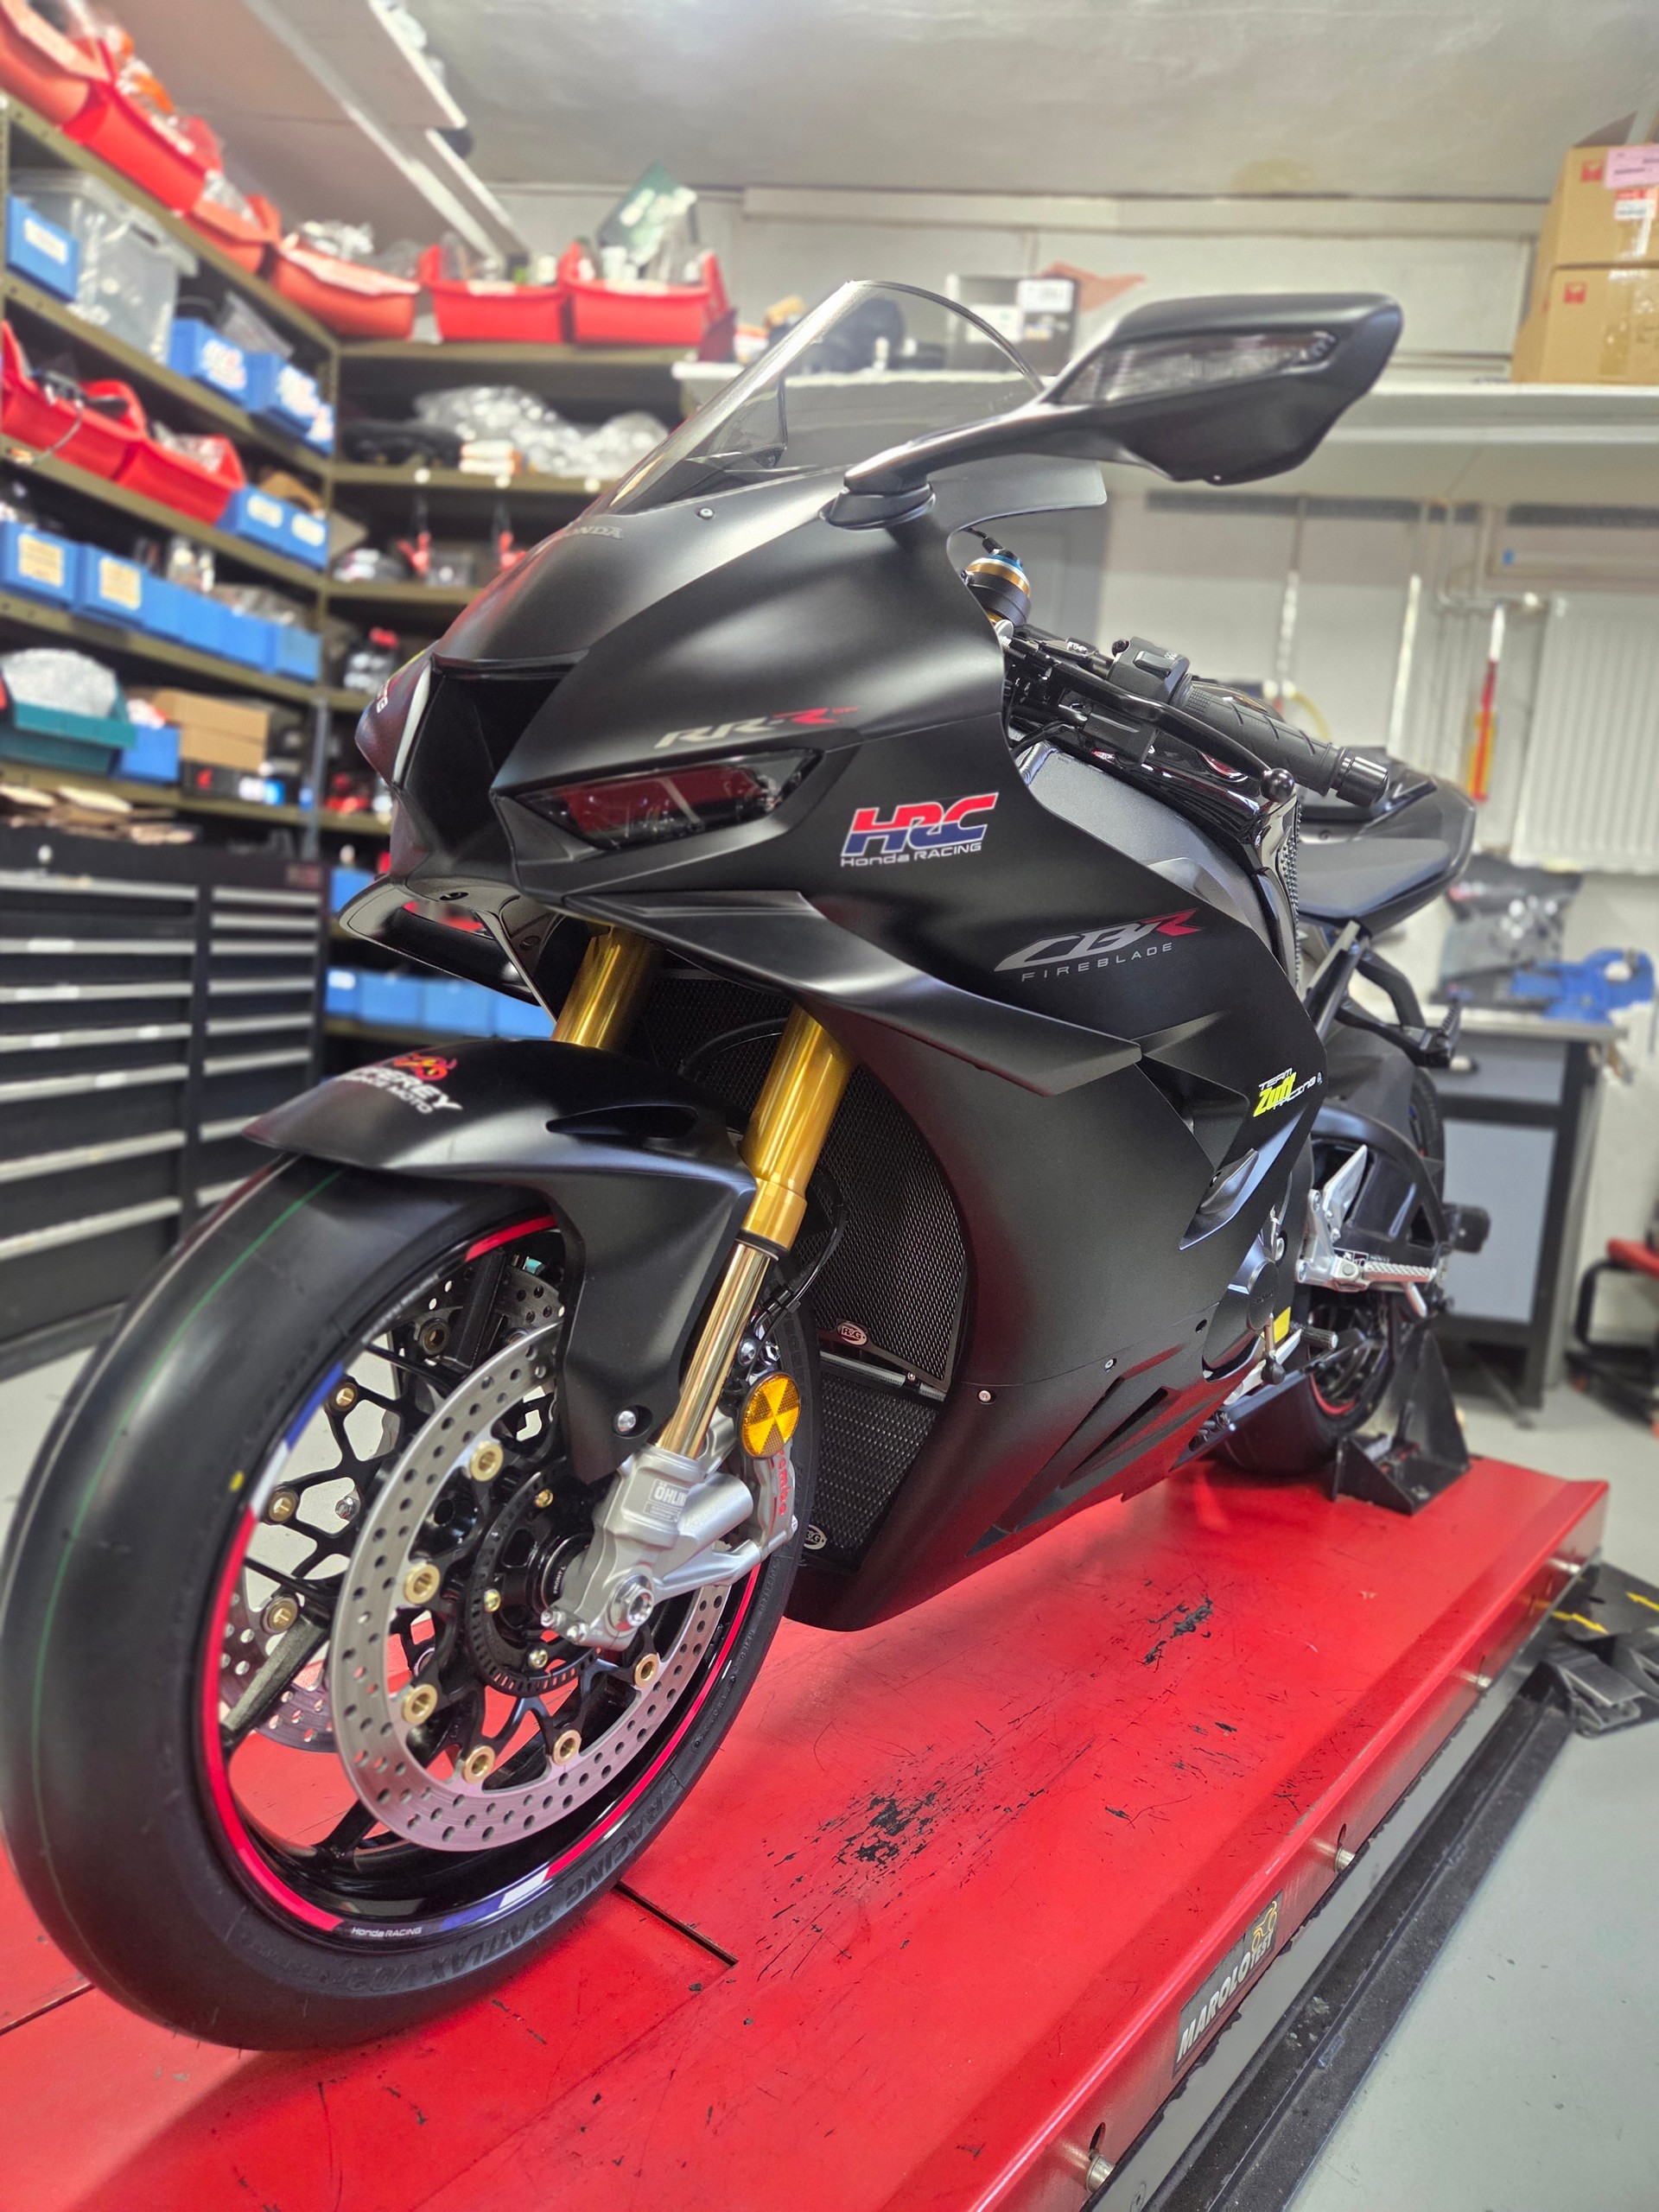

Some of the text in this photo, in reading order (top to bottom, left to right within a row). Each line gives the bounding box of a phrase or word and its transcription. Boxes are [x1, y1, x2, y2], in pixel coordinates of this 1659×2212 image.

[841, 791, 1000, 857] HRC
[841, 842, 982, 868] Honda RACING
[994, 908, 1204, 972] CBR
[1021, 942, 1173, 982] FIREBLADE
[654, 1482, 689, 1507] ÖHLIN
[776, 1449, 791, 1516] rembo
[351, 1927, 423, 1937] Honda RACING
